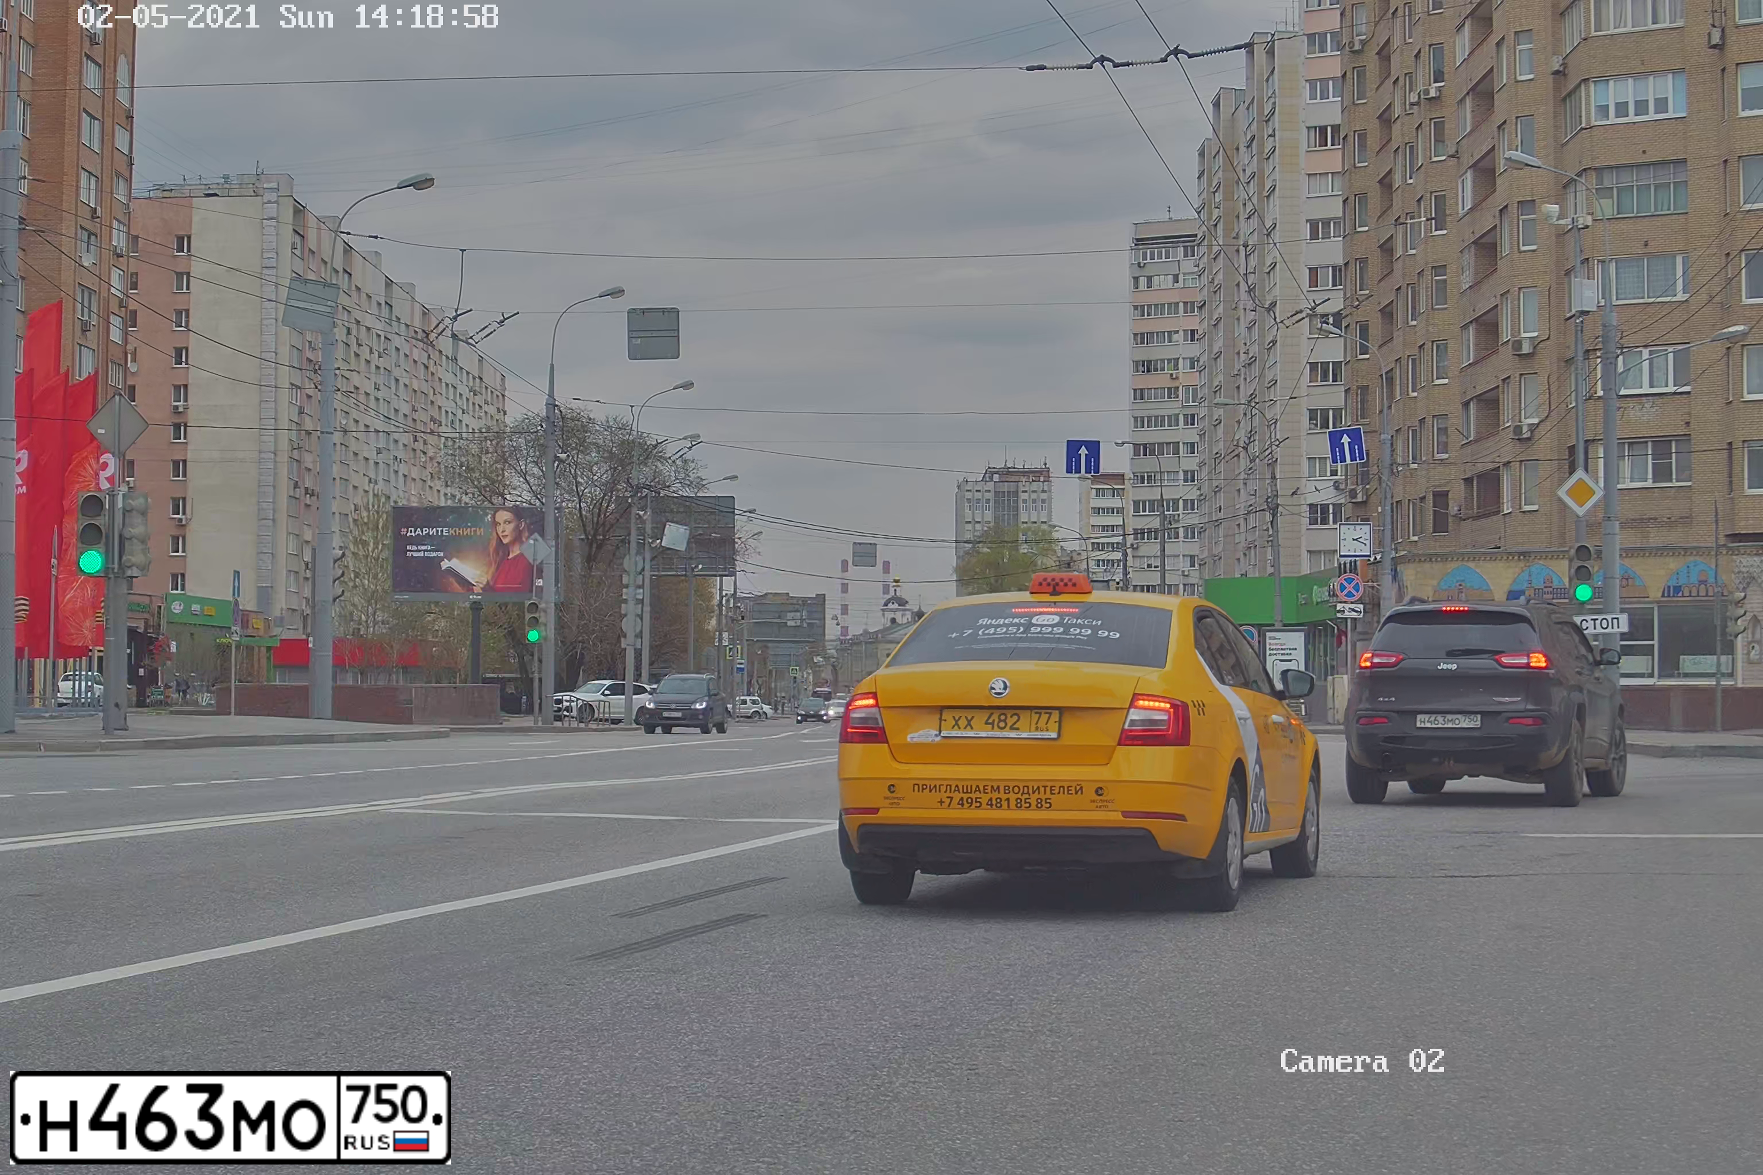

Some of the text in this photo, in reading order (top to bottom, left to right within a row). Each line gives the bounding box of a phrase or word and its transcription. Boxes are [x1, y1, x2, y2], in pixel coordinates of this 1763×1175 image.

[977, 616, 1029, 626] Яндекс
[1063, 616, 1102, 626] Такси
[1580, 616, 1620, 631] СТОП
[978, 626, 1023, 636] (495)
[1029, 626, 1064, 634] 999
[1069, 627, 1092, 635] 99
[1097, 629, 1120, 639] 99
[1437, 662, 1458, 671] Jeep
[984, 711, 1021, 731] 482
[1034, 711, 1053, 726] 77
[1462, 714, 1478, 723] 750
[912, 783, 1084, 797] ПРИГЛАШАЕМ ВОДИТЕЛЕЙ
[937, 796, 1053, 809] +7 495 481 85 85
